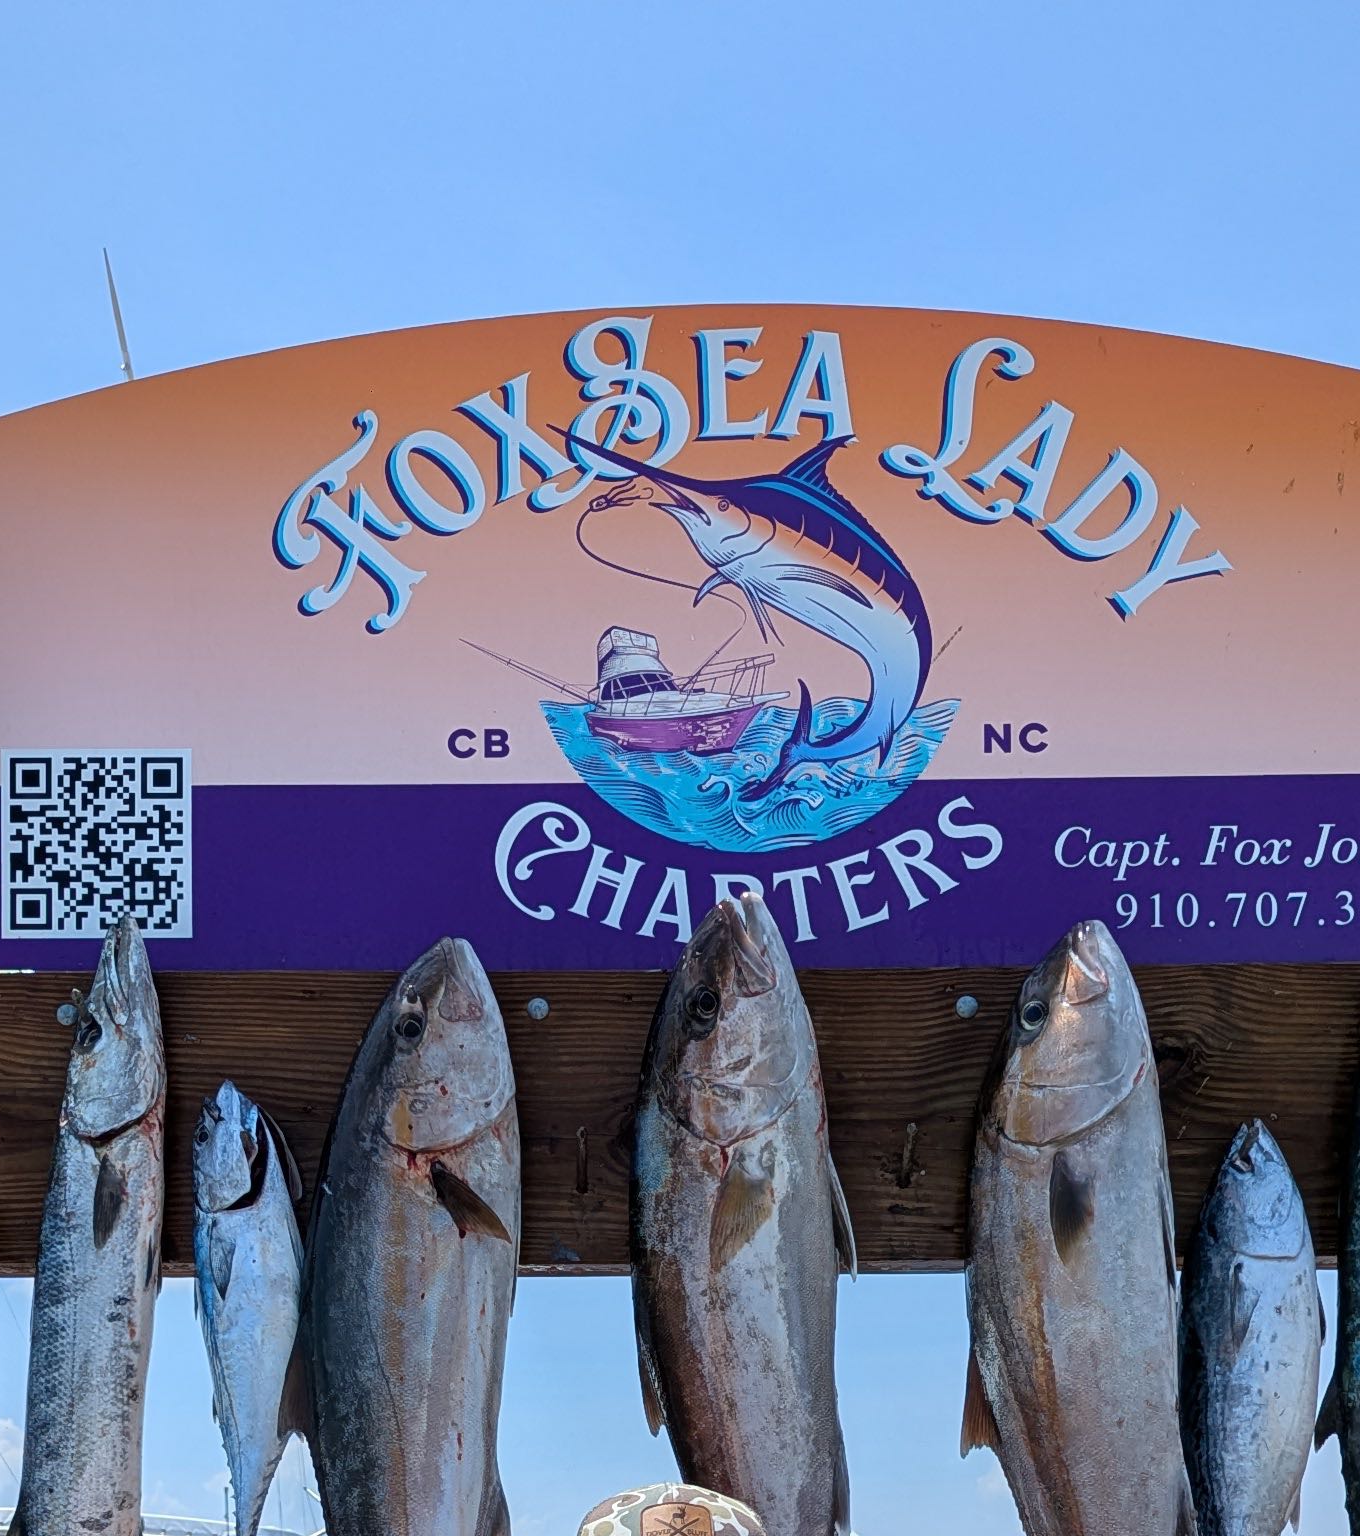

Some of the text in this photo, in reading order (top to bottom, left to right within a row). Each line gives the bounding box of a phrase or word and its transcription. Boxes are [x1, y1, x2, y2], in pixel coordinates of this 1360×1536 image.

[878, 337, 1234, 622] LADY
[447, 728, 511, 759] CB
[983, 723, 1049, 753] NC
[1054, 826, 1181, 882] Capt.
[1200, 825, 1292, 866] Fox
